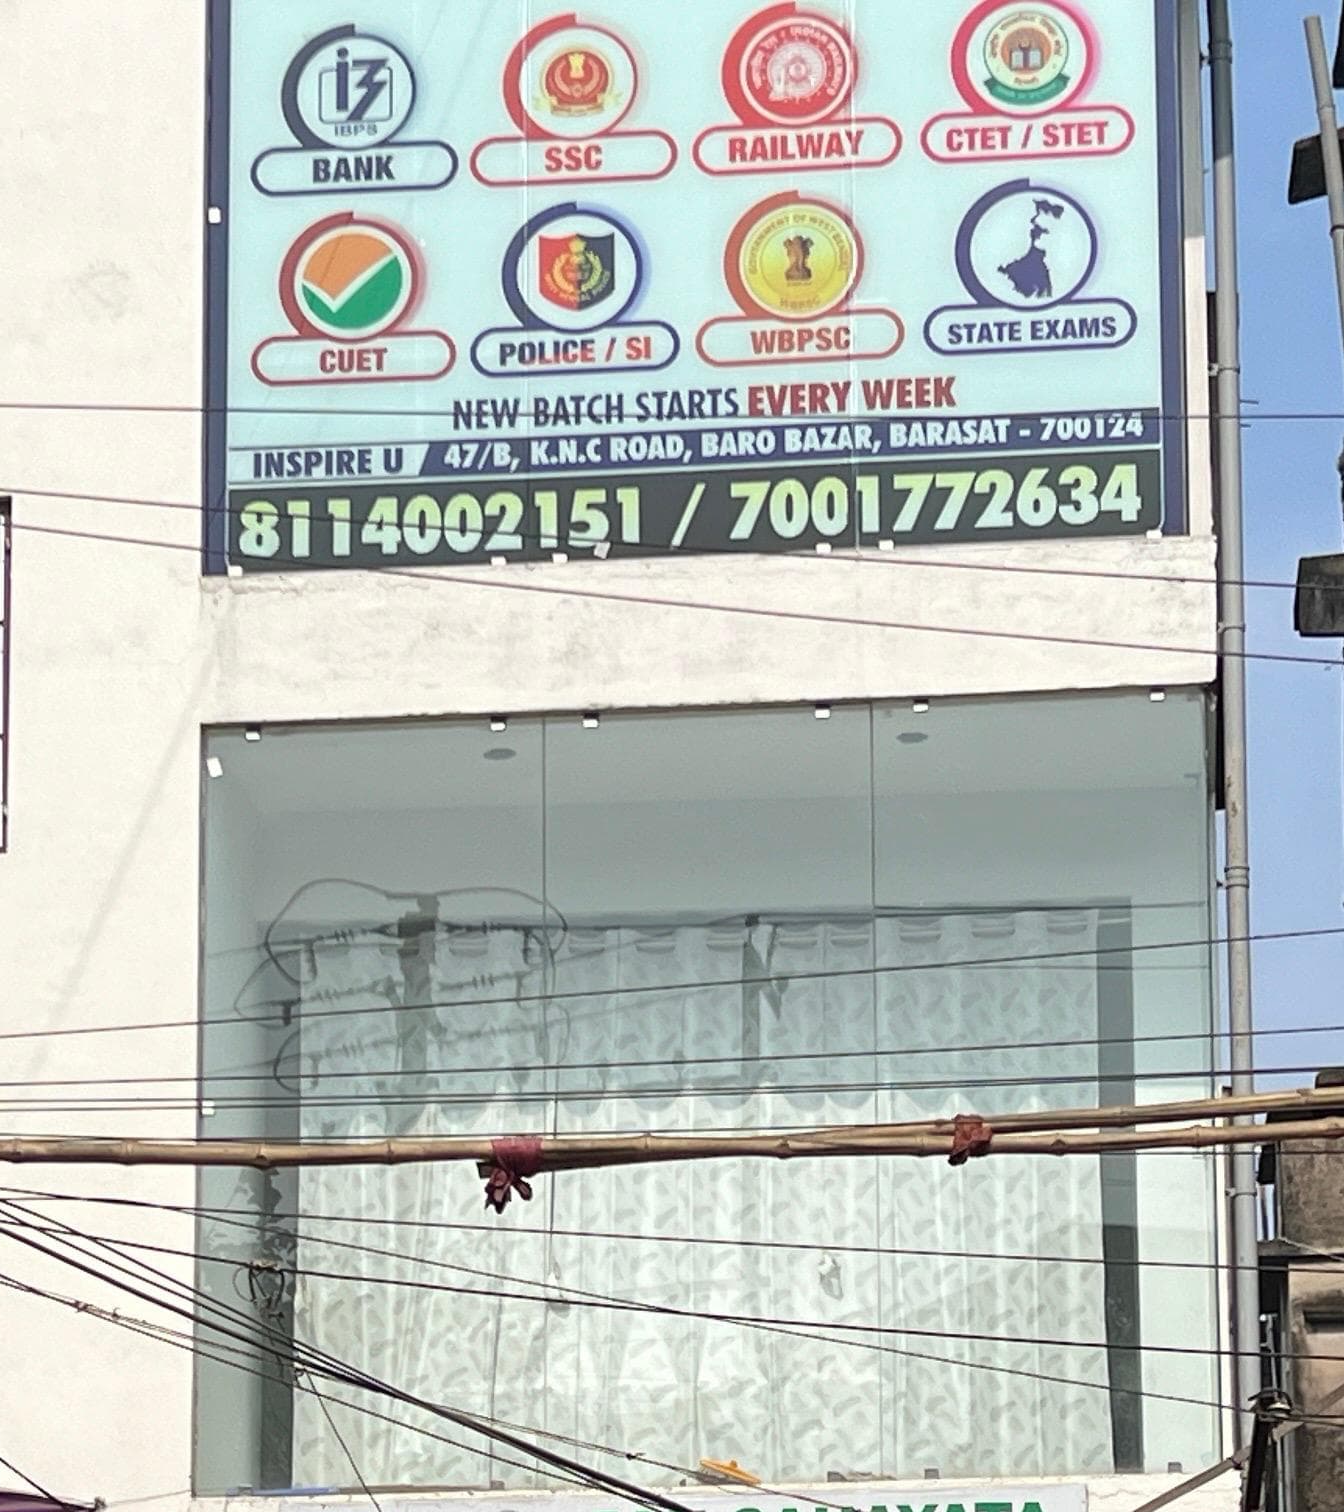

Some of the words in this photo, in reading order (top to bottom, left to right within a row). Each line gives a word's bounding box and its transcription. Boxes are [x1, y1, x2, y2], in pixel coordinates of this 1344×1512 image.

[728, 130, 865, 164] RAILWAY
[945, 125, 1013, 153] CTET
[1020, 123, 1034, 150] /
[1042, 120, 1109, 147] STET
[312, 155, 395, 184] BANK
[545, 144, 603, 173] SSC
[750, 326, 852, 355] WBPSC
[947, 320, 1023, 346] STATE
[1030, 315, 1117, 341] EXAMS
[319, 347, 388, 374] CUET
[499, 337, 596, 367] POLICE
[605, 337, 617, 363] /
[625, 335, 653, 362] SI
[453, 398, 520, 431] NEW
[533, 392, 625, 428] BATCH
[635, 386, 738, 424] STARTS
[747, 380, 852, 417] EVERY
[861, 376, 957, 411] WEEK
[253, 446, 373, 480] INSPIRE
[383, 446, 404, 475] U
[443, 441, 521, 473] 47/B,
[530, 436, 601, 466] K.N.C
[609, 433, 694, 463] ROAD,
[701, 429, 776, 458] BARO
[783, 425, 882, 455] BAZAR,
[888, 418, 1011, 449] BARASAT
[1040, 411, 1144, 442] 700124
[238, 485, 641, 559] 8114002151
[671, 482, 707, 550] /
[729, 463, 1143, 541] 7001772634
